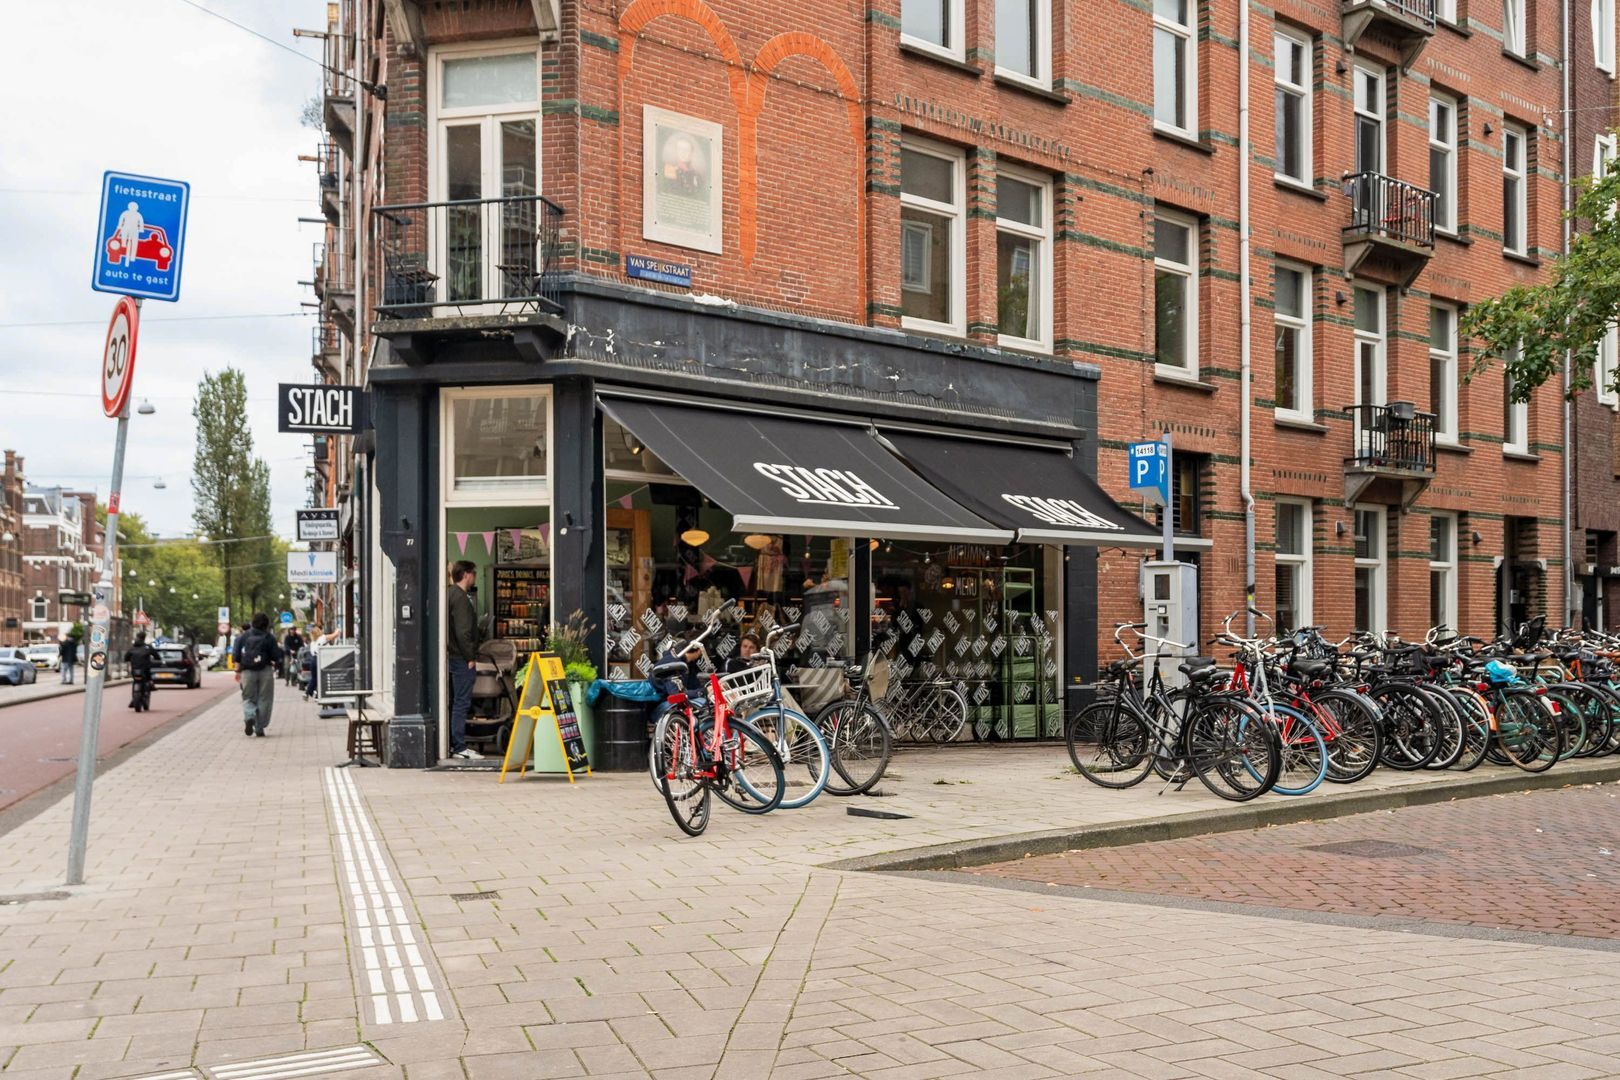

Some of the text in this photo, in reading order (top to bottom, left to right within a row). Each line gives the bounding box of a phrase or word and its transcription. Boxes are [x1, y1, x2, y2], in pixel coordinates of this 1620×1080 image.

[114, 184, 177, 202] fietsstraat
[630, 257, 645, 268] VAN
[105, 269, 169, 285] auto te gast
[107, 334, 127, 379] 30
[288, 387, 353, 426] STACH
[1136, 447, 1154, 455] 14118
[753, 462, 895, 506] STACH
[1137, 459, 1149, 484] P
[1159, 459, 1165, 484] P
[1001, 493, 1119, 528] STACH
[640, 607, 663, 634] STACH
